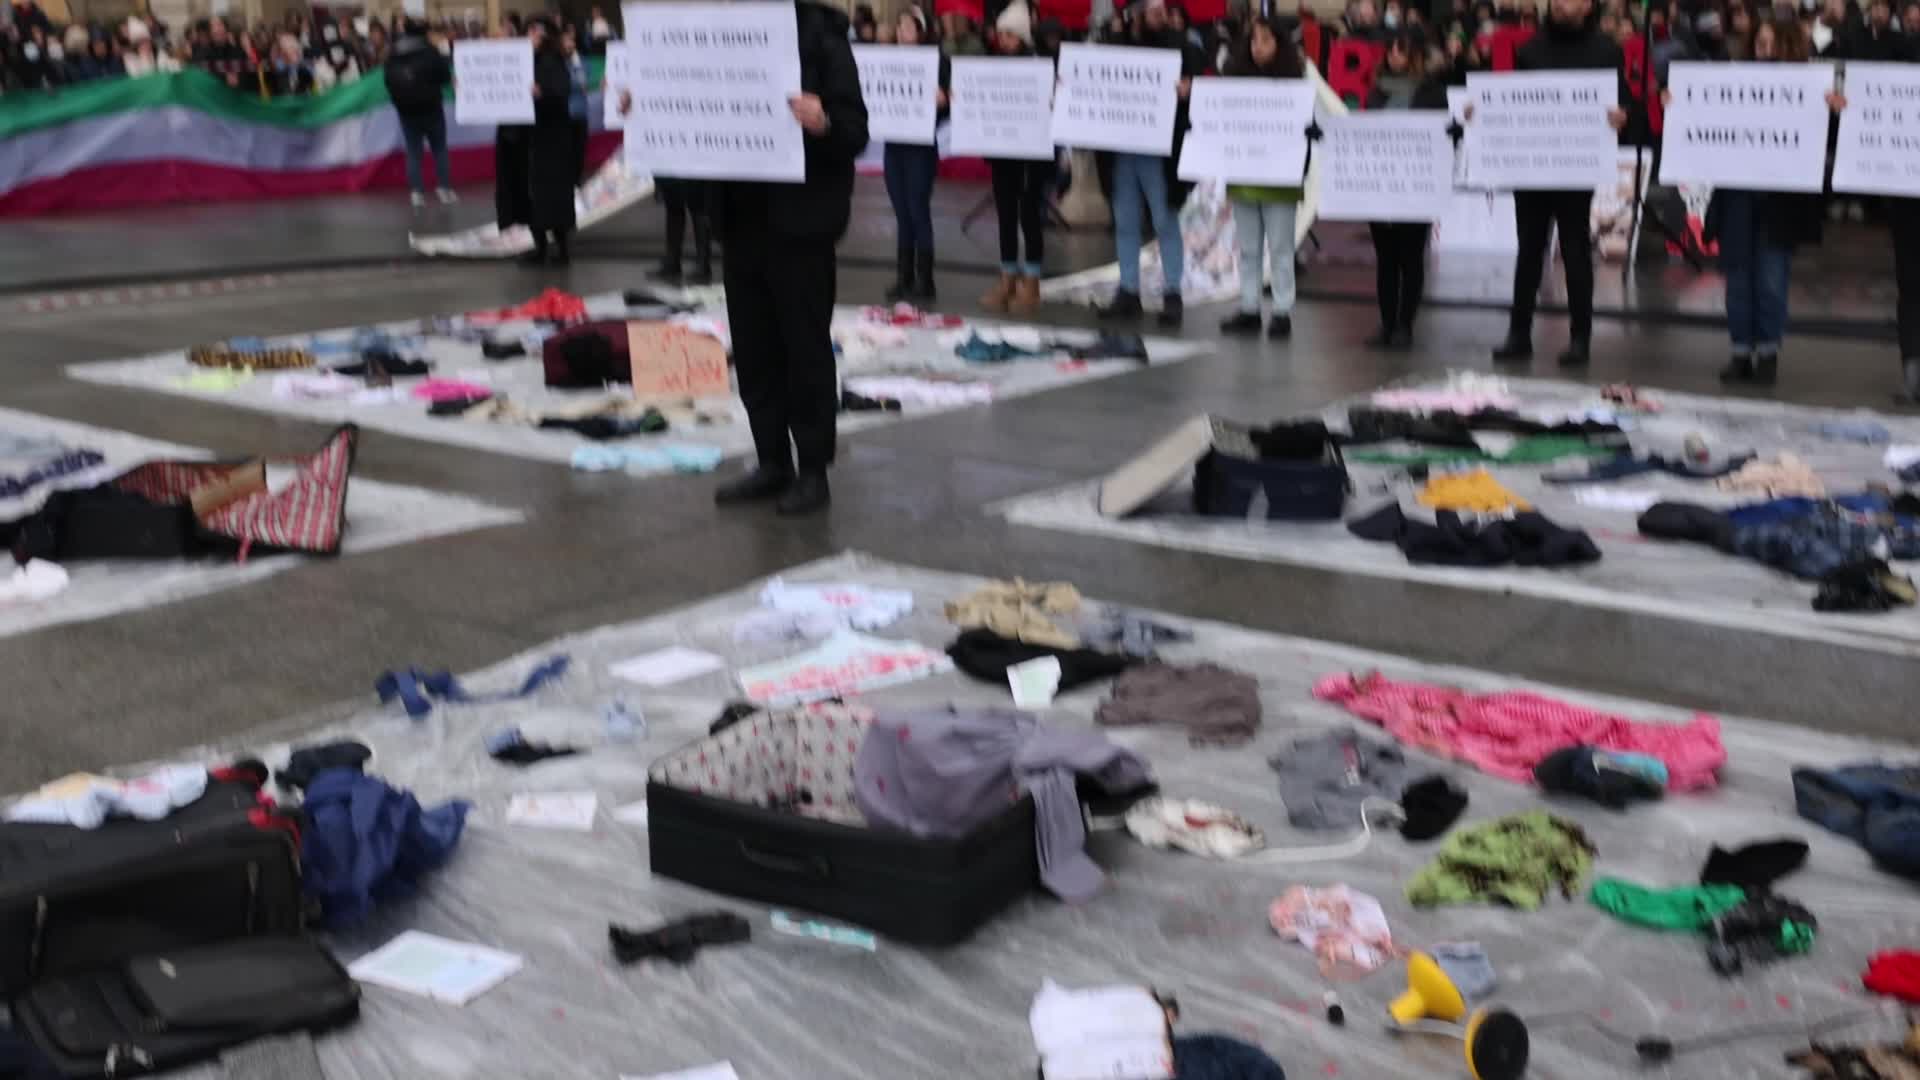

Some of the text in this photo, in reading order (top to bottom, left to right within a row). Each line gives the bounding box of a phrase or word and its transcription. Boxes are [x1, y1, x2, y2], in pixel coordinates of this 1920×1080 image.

[693, 27, 708, 48] DI
[711, 27, 769, 48] CRIMINI
[1088, 63, 1161, 87] CRIMINI
[1499, 88, 1563, 105] CRIMINE
[1702, 82, 1806, 109] CRIMINI
[694, 130, 776, 152] PROCESSO
[1683, 124, 1802, 150] AMBIENTALI
